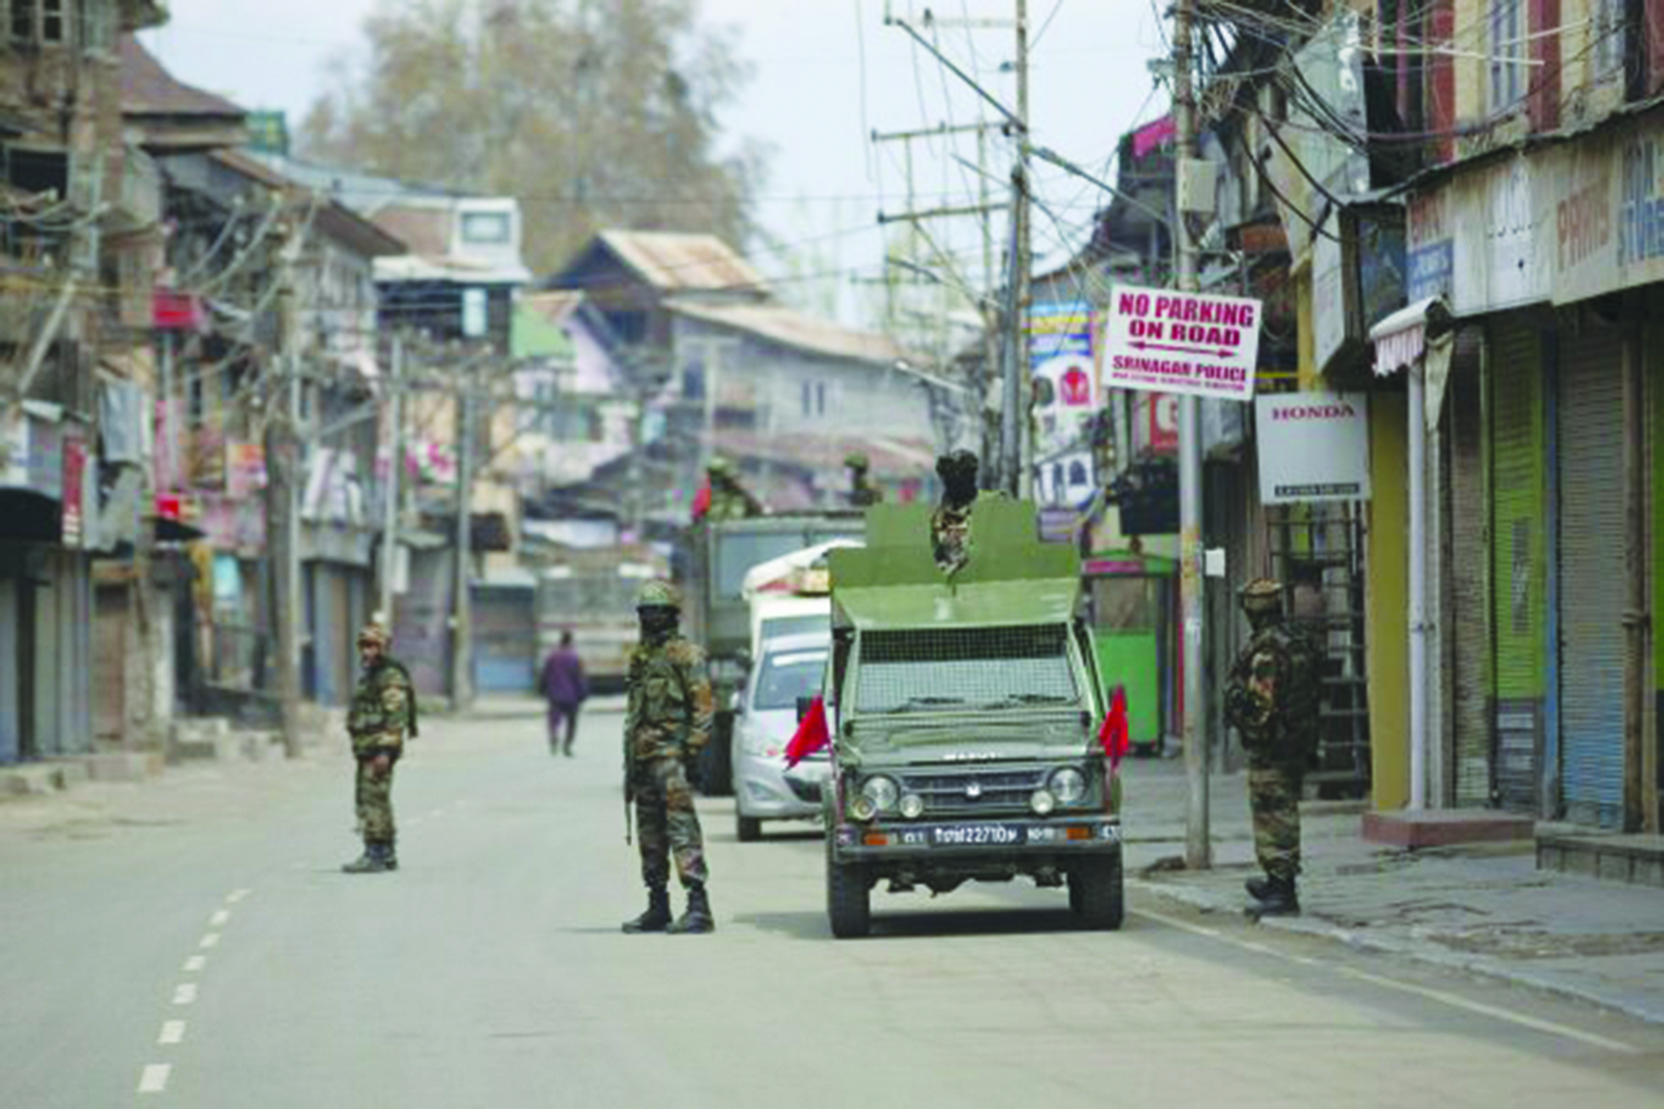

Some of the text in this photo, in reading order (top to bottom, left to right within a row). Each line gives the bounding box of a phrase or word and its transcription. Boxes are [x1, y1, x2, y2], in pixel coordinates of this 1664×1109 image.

[1119, 293, 1254, 328] NO PARKING
[1129, 319, 1241, 347] ON ROAD
[1112, 354, 1192, 376] SRINAGAR
[1272, 403, 1355, 420] HONDA
